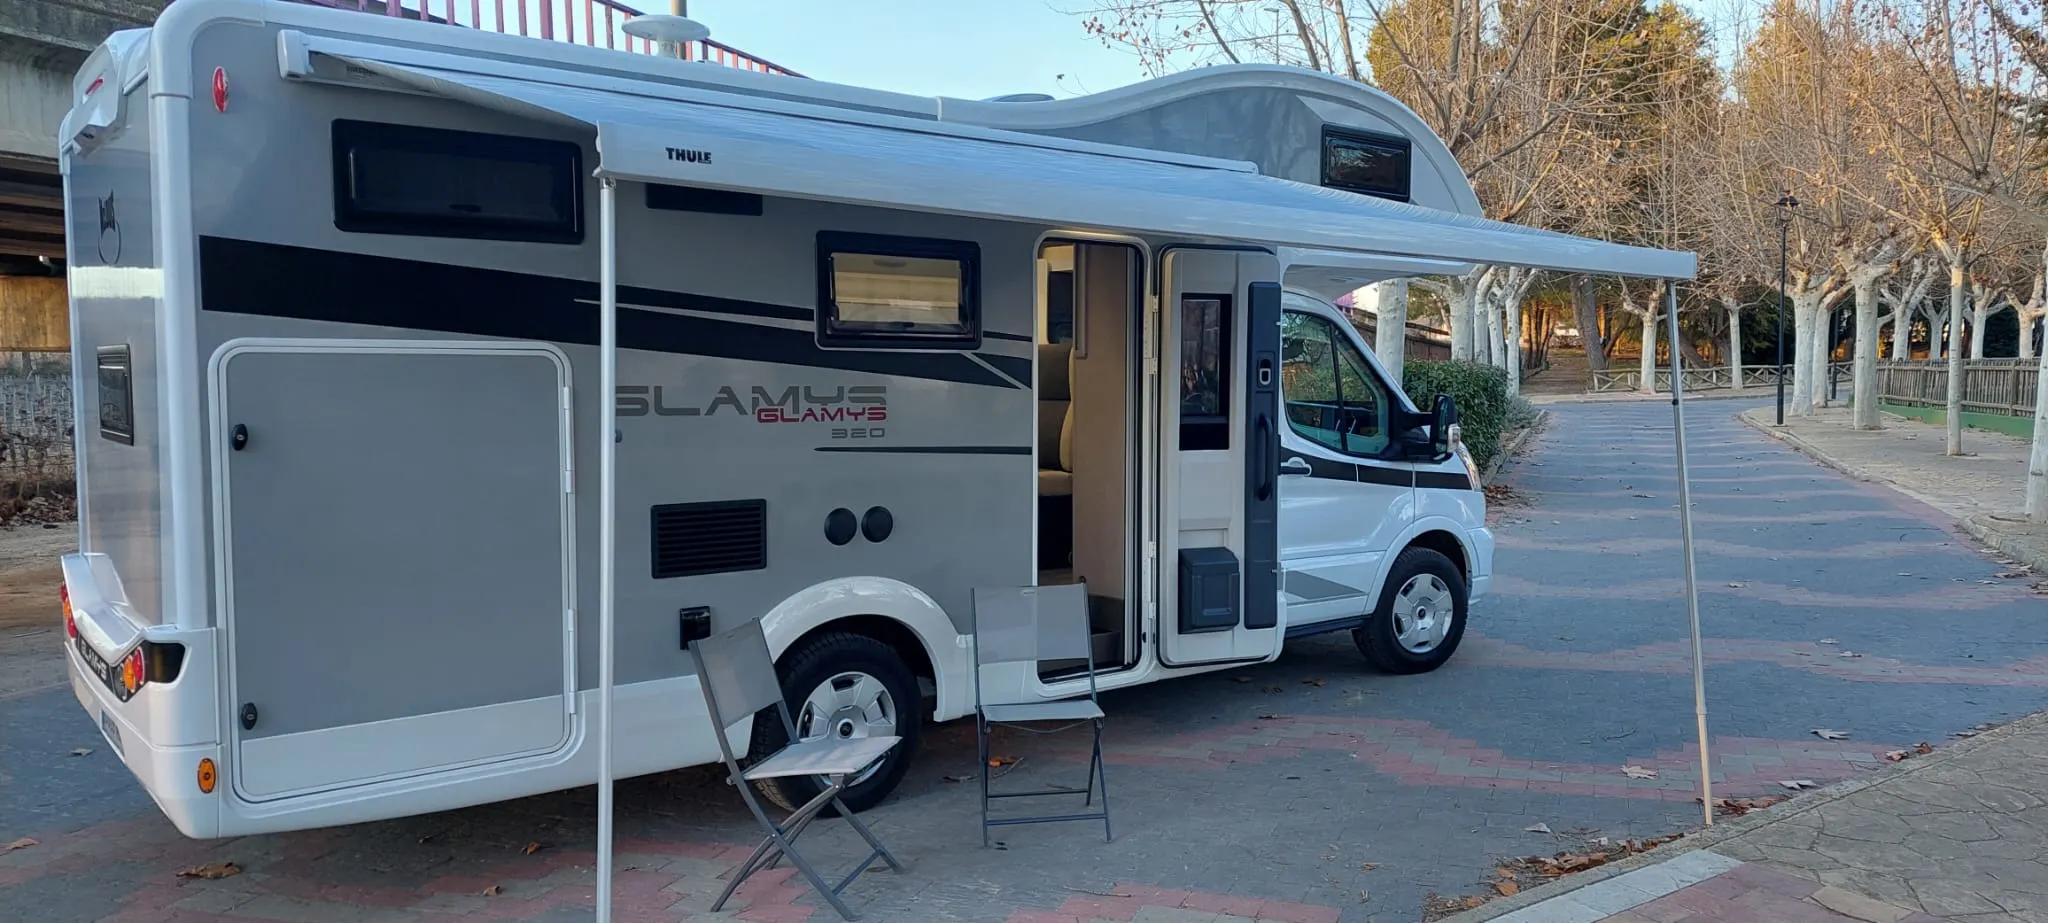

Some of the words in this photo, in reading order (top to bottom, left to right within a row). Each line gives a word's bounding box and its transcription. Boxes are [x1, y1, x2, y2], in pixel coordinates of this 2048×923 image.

[665, 147, 712, 165] THULE
[757, 406, 887, 423] GLAMYS
[831, 428, 885, 439] 320
